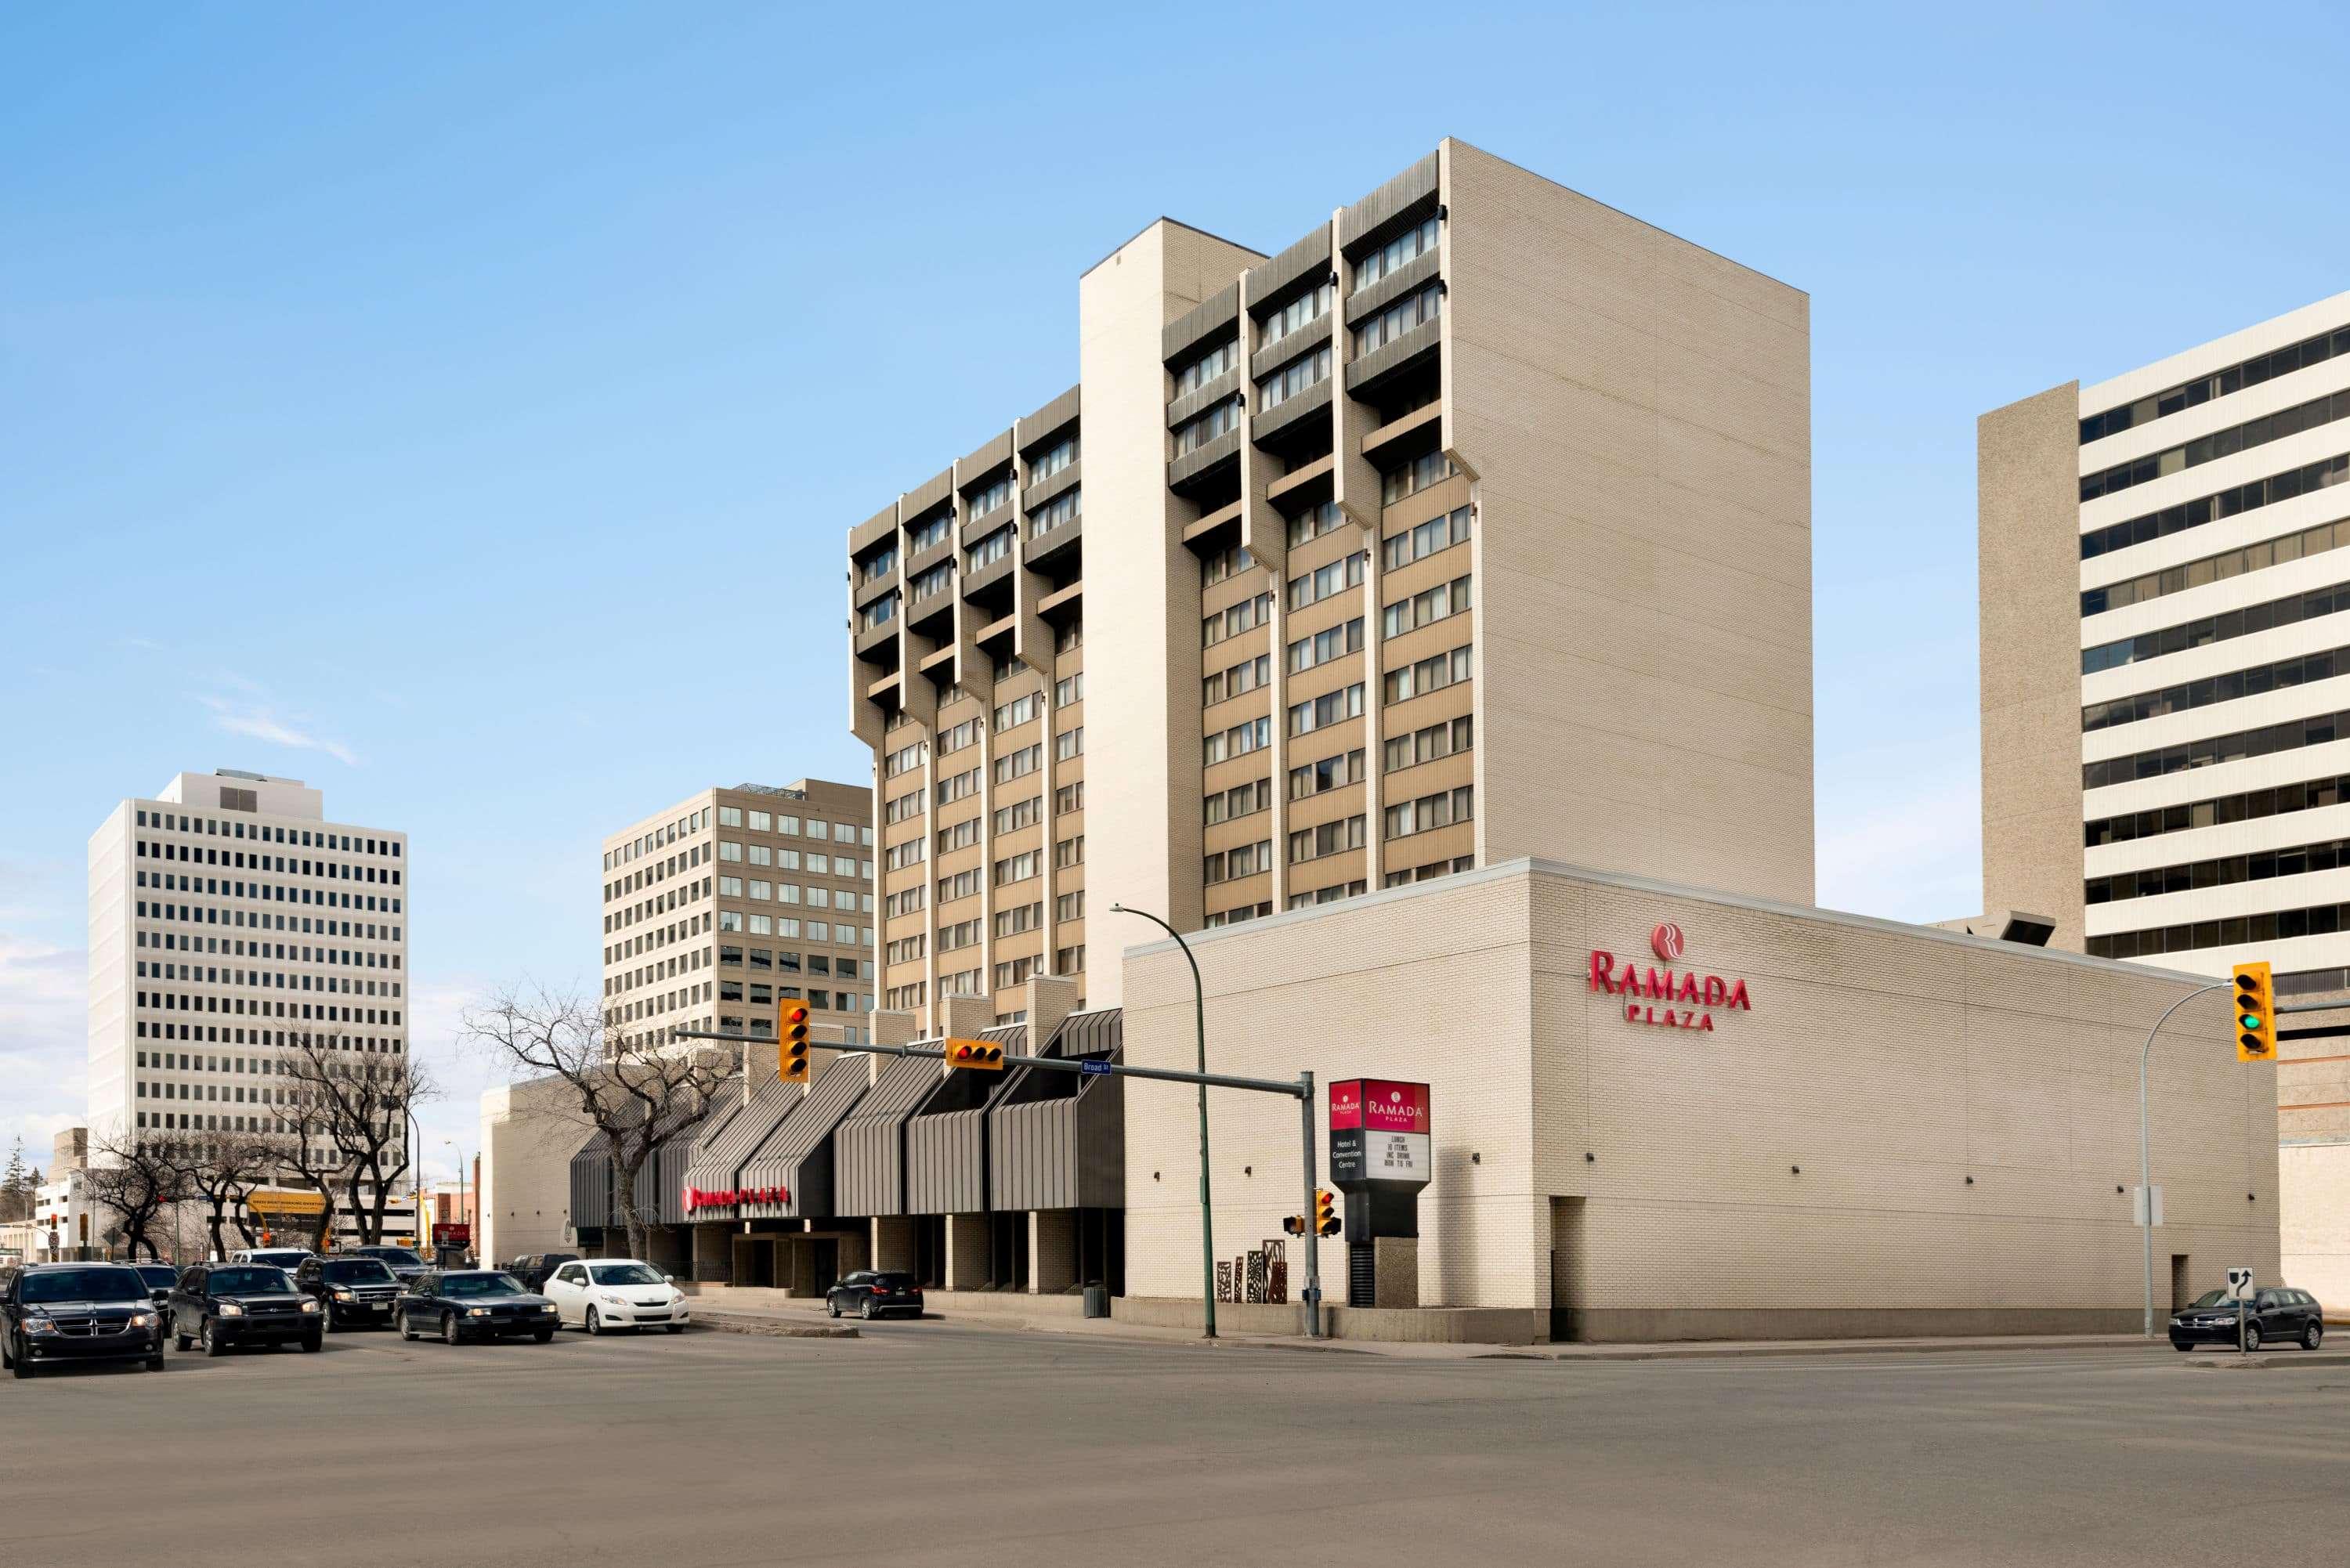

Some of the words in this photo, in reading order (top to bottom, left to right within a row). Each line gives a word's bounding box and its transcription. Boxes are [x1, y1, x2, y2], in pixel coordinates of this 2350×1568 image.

[1591, 949, 1752, 1011] RAMADA
[1627, 1004, 1714, 1031] PLAZA
[1083, 1062, 1102, 1071] Broad
[1332, 1103, 1360, 1111] RAMADA
[1368, 1100, 1423, 1117] RAMADA
[739, 1186, 788, 1204] PLAZA
